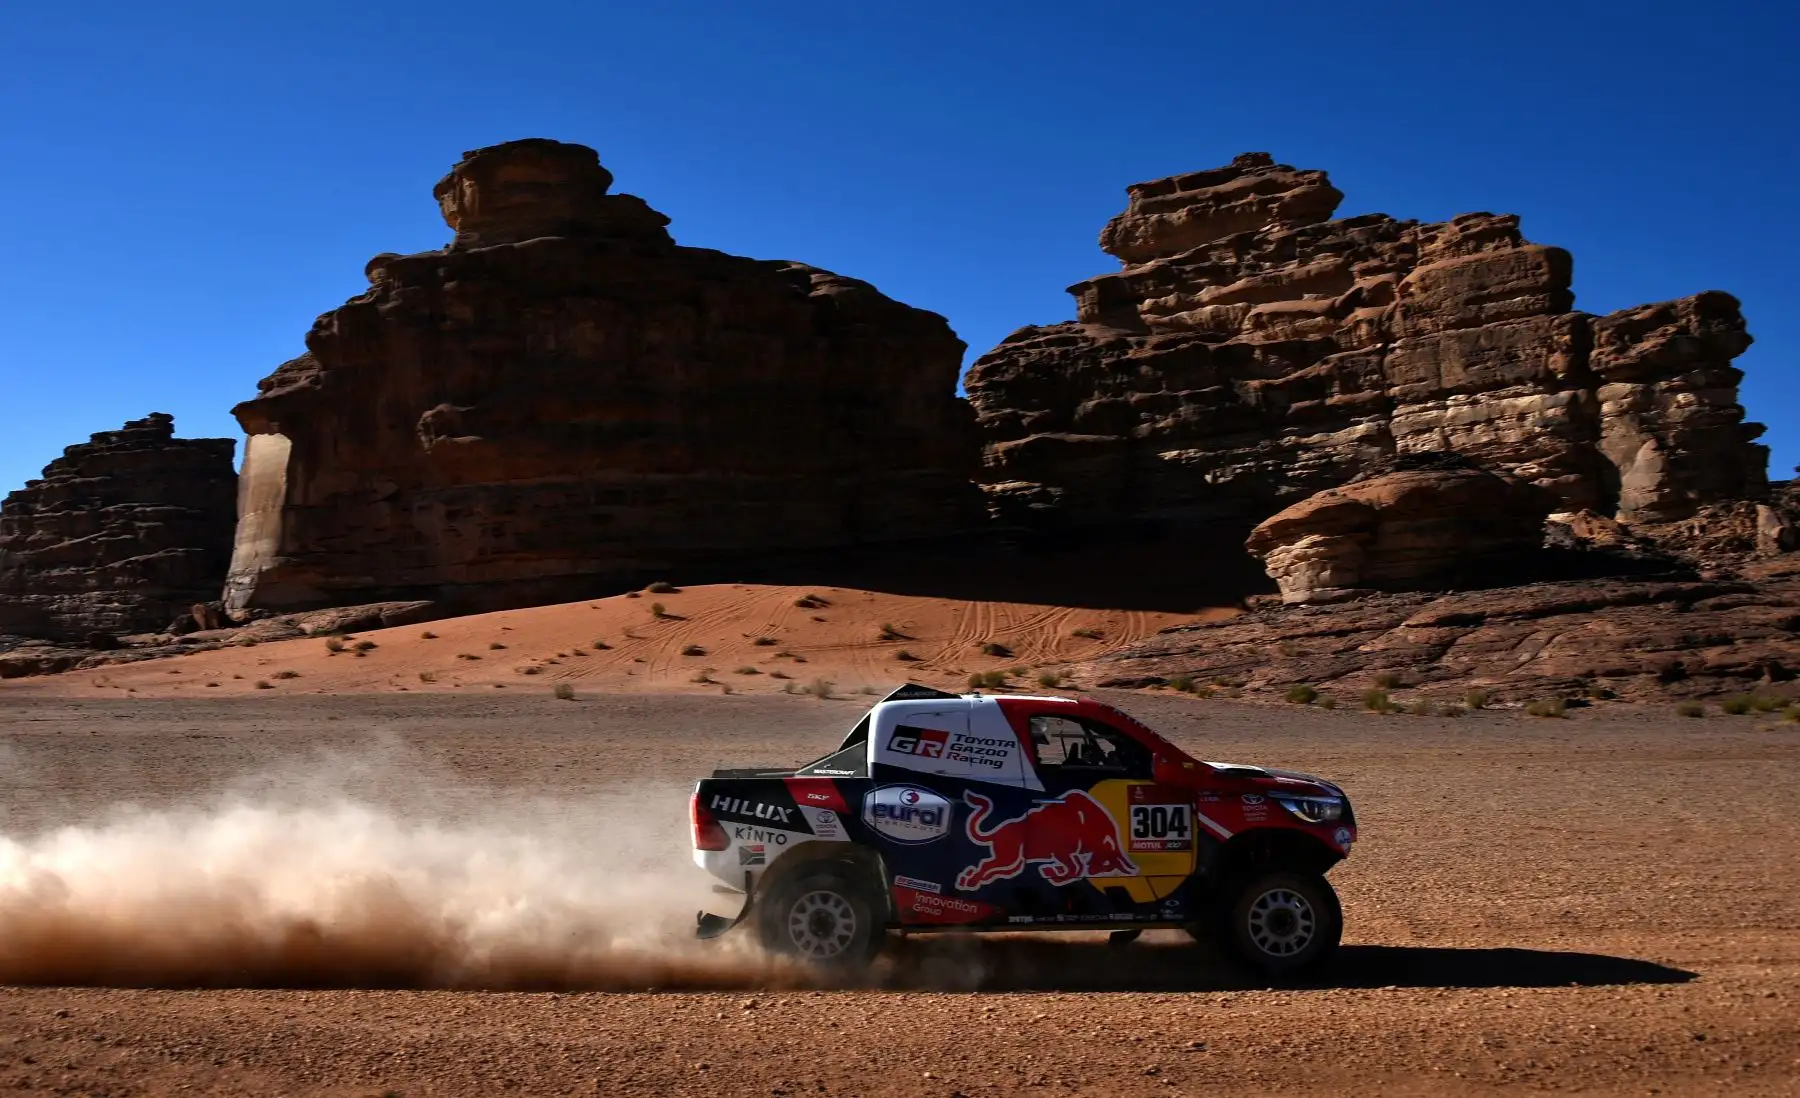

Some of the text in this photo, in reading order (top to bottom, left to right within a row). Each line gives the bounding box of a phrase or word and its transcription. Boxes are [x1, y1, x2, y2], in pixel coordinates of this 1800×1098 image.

[890, 735, 944, 758] GR
[950, 742, 1008, 758] GAZOO
[954, 733, 1016, 749] TOYOTA
[946, 751, 1004, 770] Racing
[711, 794, 795, 824] HILUX
[872, 802, 945, 827] eurol
[1133, 806, 1188, 839] 304
[1132, 841, 1162, 850] MOTUL
[912, 903, 943, 917] Group
[915, 891, 978, 914] Innovation
